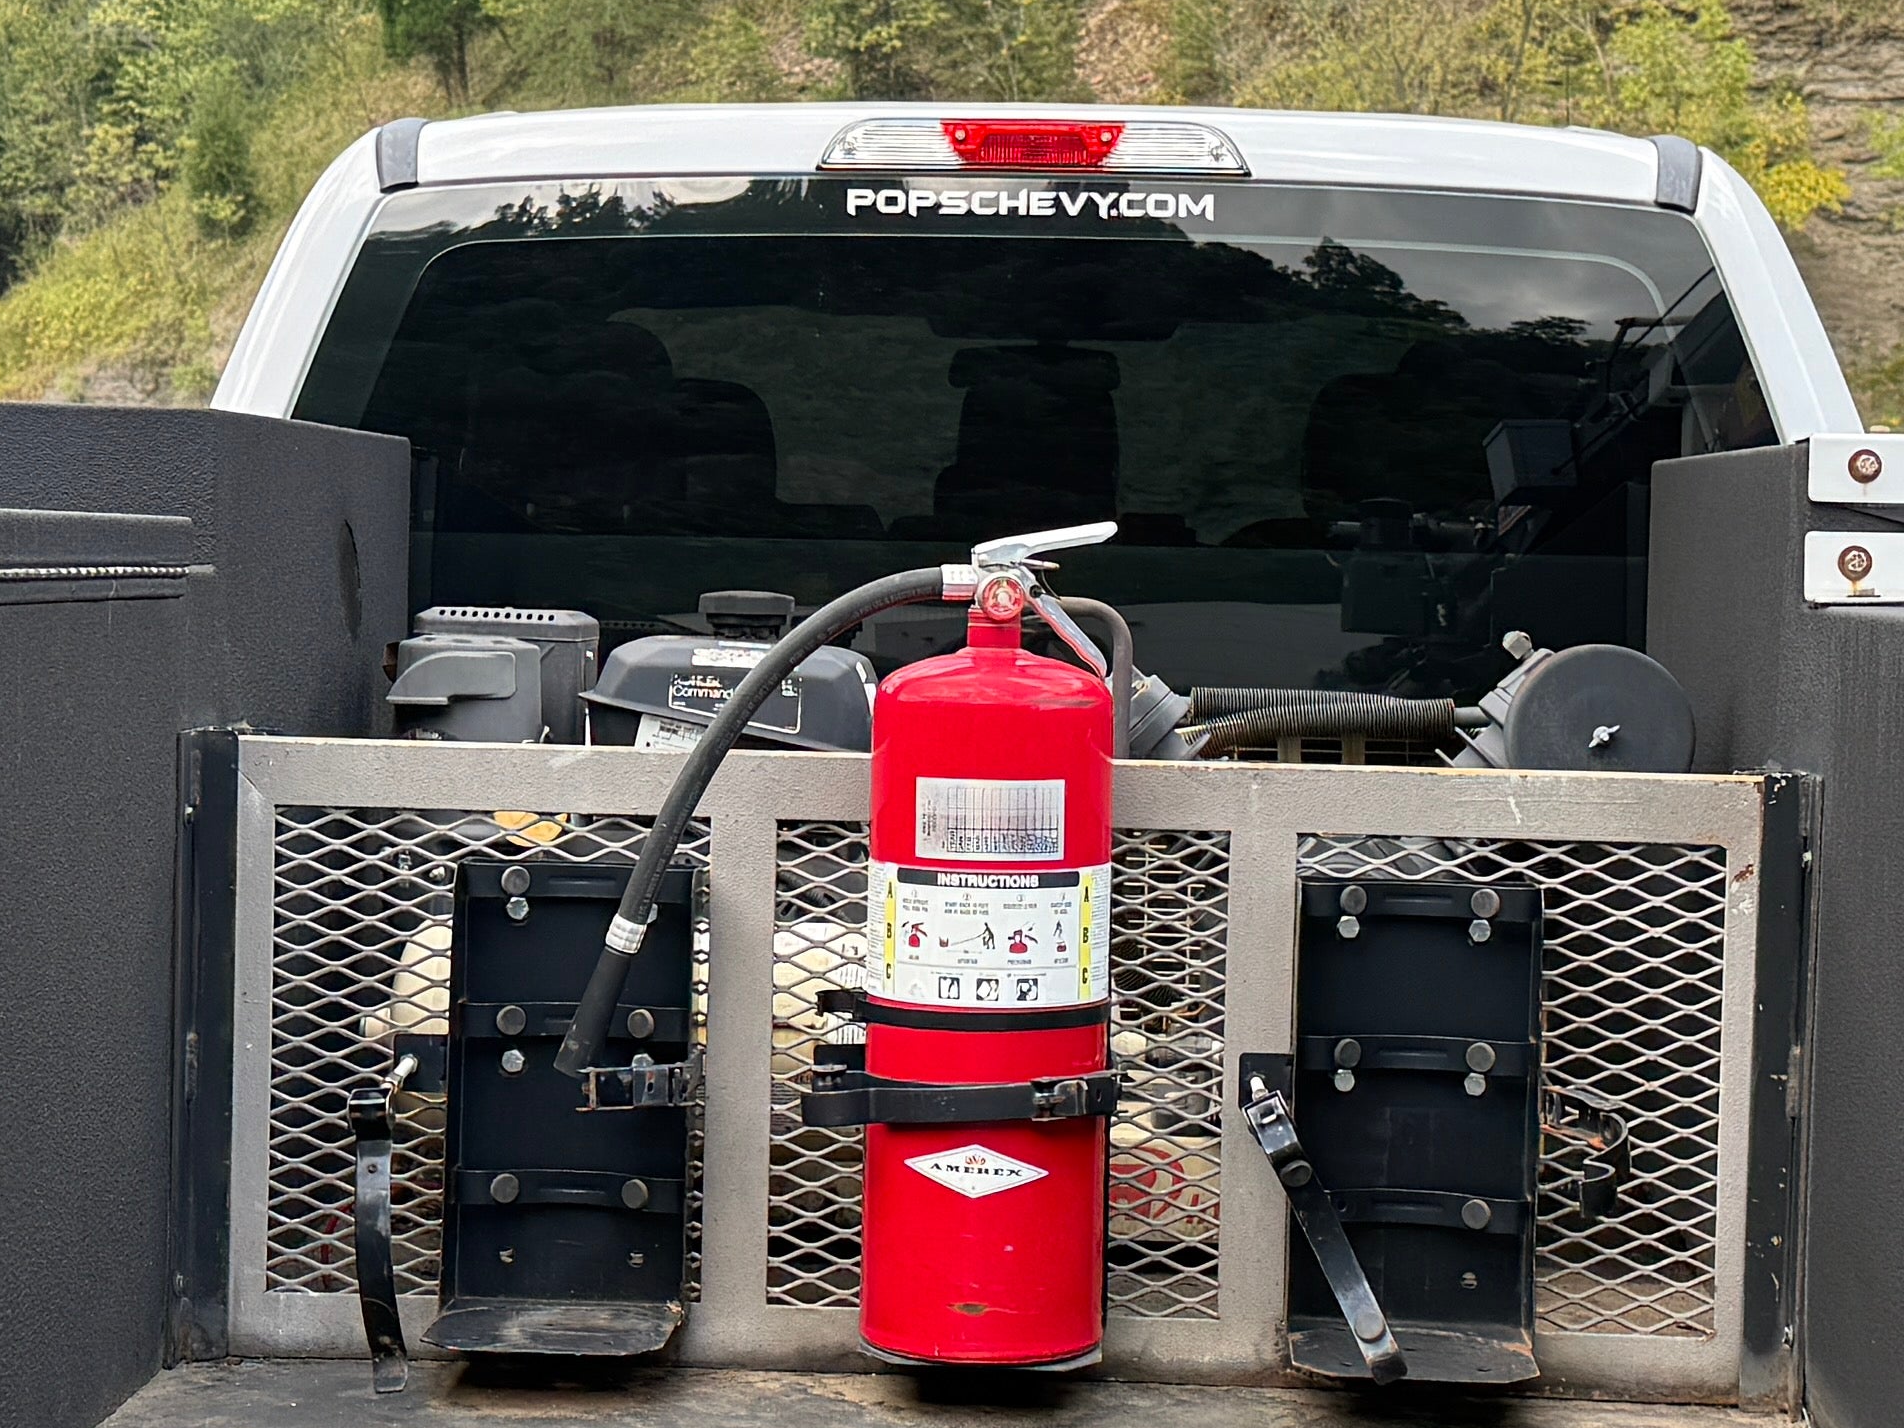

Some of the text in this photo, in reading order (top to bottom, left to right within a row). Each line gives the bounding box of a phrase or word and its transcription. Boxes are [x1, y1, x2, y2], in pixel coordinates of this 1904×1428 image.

[846, 187, 1215, 221] POPSCHEVY.COM
[936, 872, 1039, 888] INSTRUCTIONS
[886, 881, 893, 899] A
[1083, 885, 1090, 903] A
[886, 922, 892, 939] B
[1082, 927, 1089, 944] B
[886, 963, 892, 980] C
[1081, 967, 1088, 984] C
[930, 1162, 1024, 1177] AMEREX
